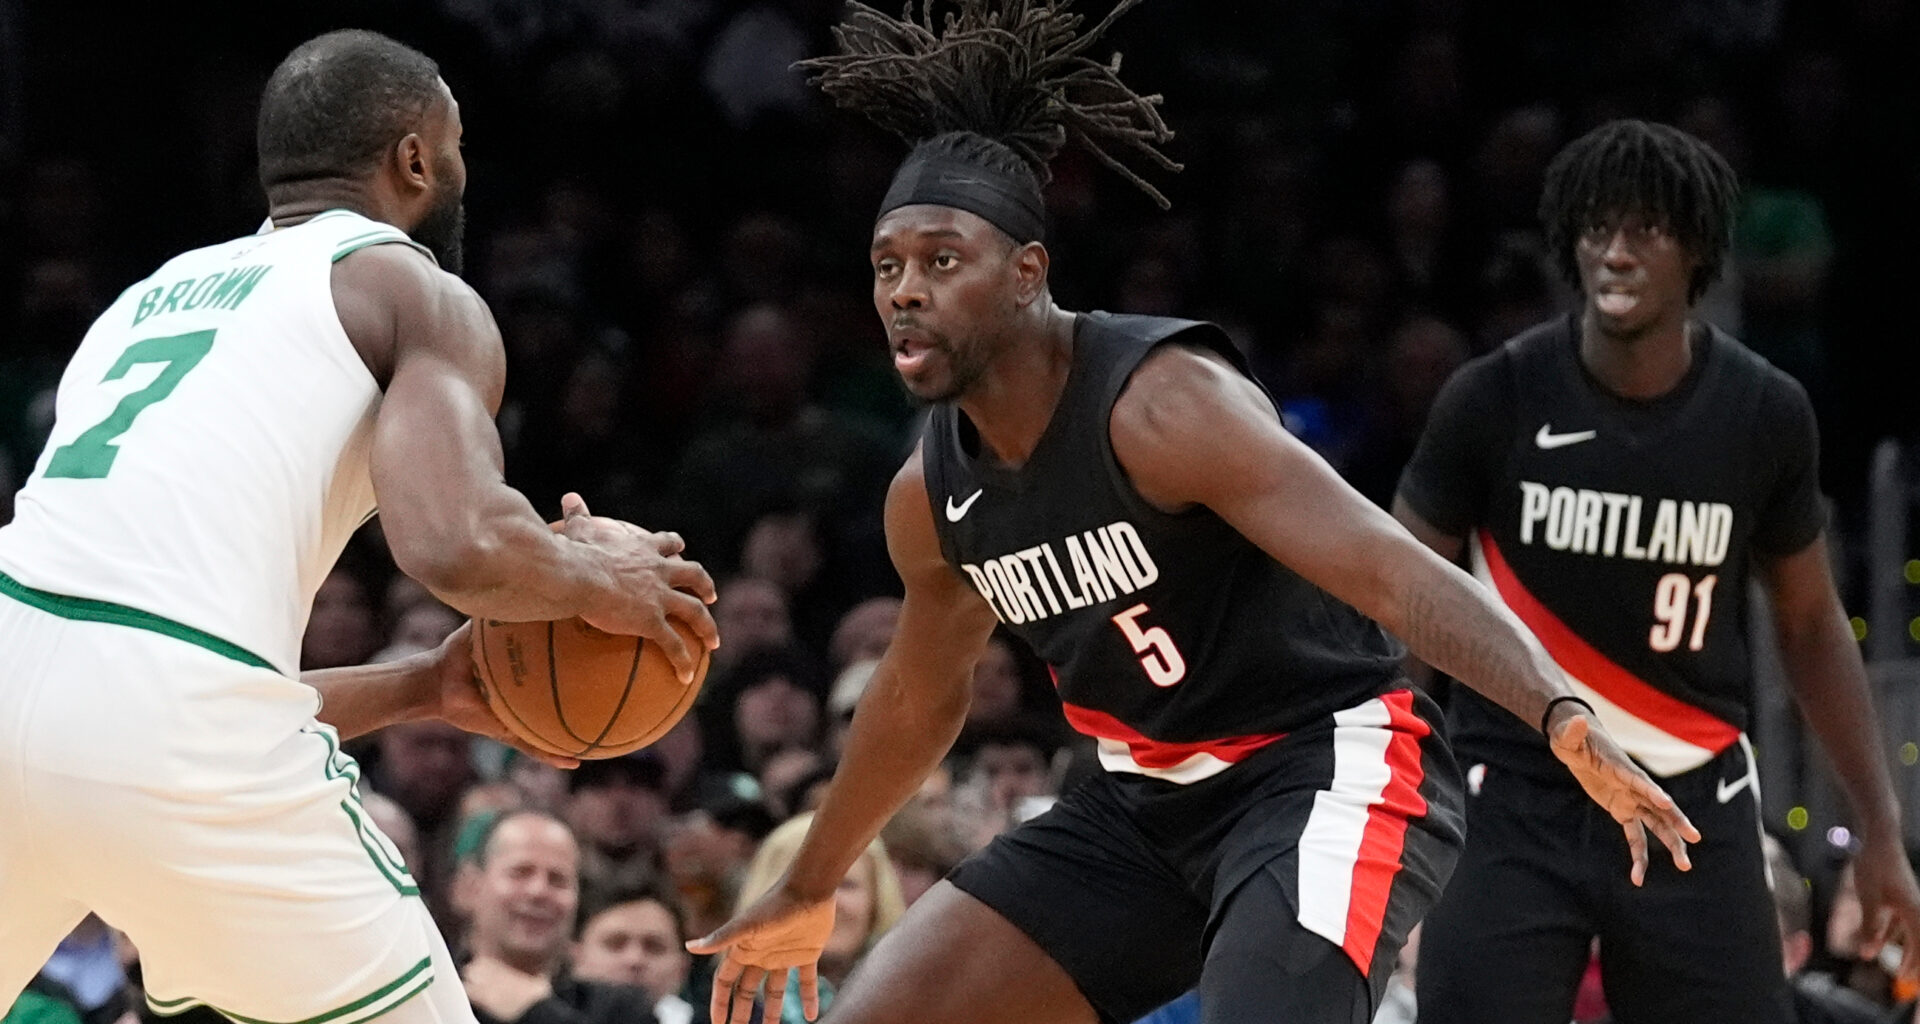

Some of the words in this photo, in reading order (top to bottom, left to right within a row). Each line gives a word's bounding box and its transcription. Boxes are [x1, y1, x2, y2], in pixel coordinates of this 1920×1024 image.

[131, 265, 274, 328] BROWN
[42, 328, 218, 478] 7
[1519, 481, 1733, 566] PORTLAND
[961, 521, 1159, 625] PORTLAND
[1650, 573, 1717, 652] 91
[1111, 602, 1186, 687] 5
